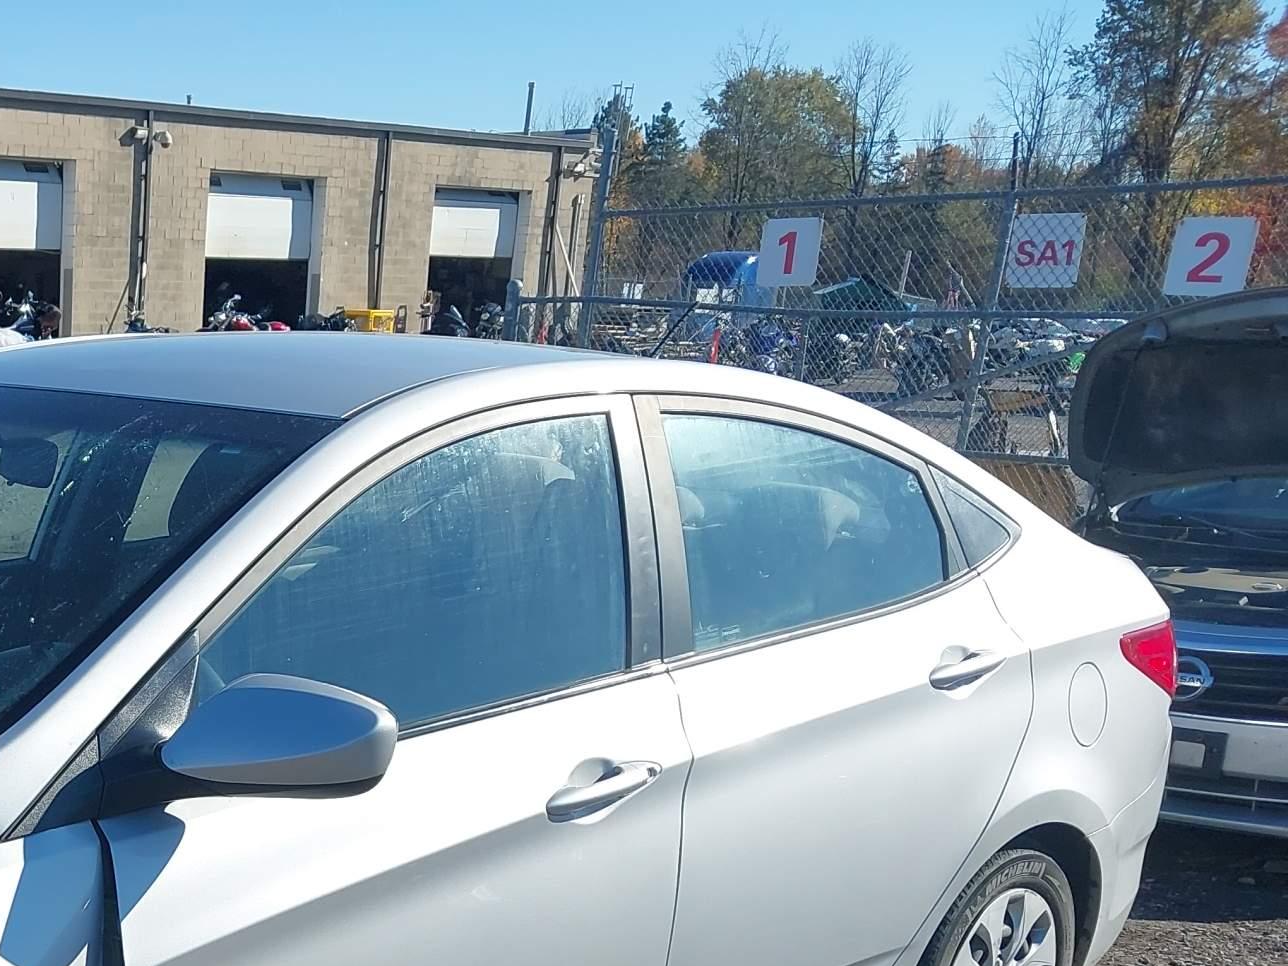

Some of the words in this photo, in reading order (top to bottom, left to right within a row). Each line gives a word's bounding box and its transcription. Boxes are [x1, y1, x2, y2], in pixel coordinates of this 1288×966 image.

[778, 231, 798, 275] 1
[1014, 239, 1076, 268] SA1
[1185, 231, 1232, 283] 2
